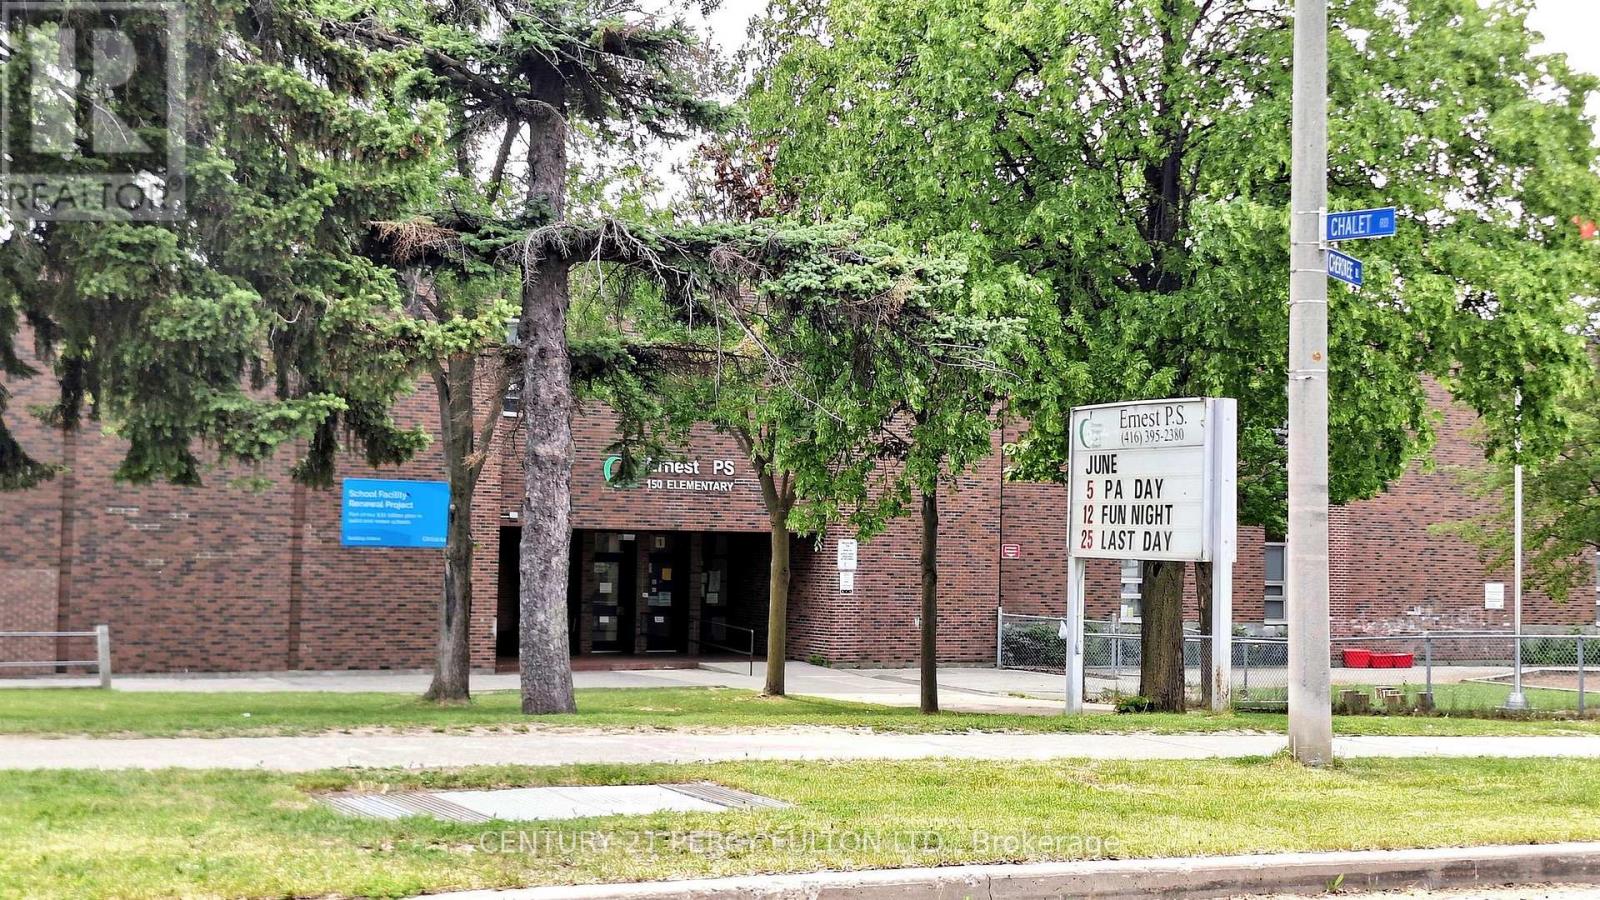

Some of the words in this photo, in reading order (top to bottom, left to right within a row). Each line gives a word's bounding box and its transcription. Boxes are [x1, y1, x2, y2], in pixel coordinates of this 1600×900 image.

[1331, 214, 1372, 236] CHALET
[1120, 408, 1160, 428] Ernest
[1165, 405, 1188, 426] P.S.
[1121, 430, 1143, 447] (416)
[1145, 428, 1184, 443] 395-2380
[713, 460, 735, 476] PS
[1086, 454, 1117, 474] JUNE
[349, 489, 377, 499] School
[378, 490, 407, 501] Facility
[647, 479, 663, 489] 150
[666, 480, 734, 491] ELEMENTARY
[1086, 480, 1094, 499] 5
[1104, 479, 1123, 499] PA
[1134, 478, 1164, 499] DAY
[385, 501, 414, 511] Project
[1083, 504, 1094, 524] 12
[1101, 504, 1126, 524] FUN
[1130, 504, 1173, 525] NIGHT
[1080, 529, 1093, 549] 25
[1100, 530, 1135, 550] LAST
[1143, 530, 1173, 551] DAY
